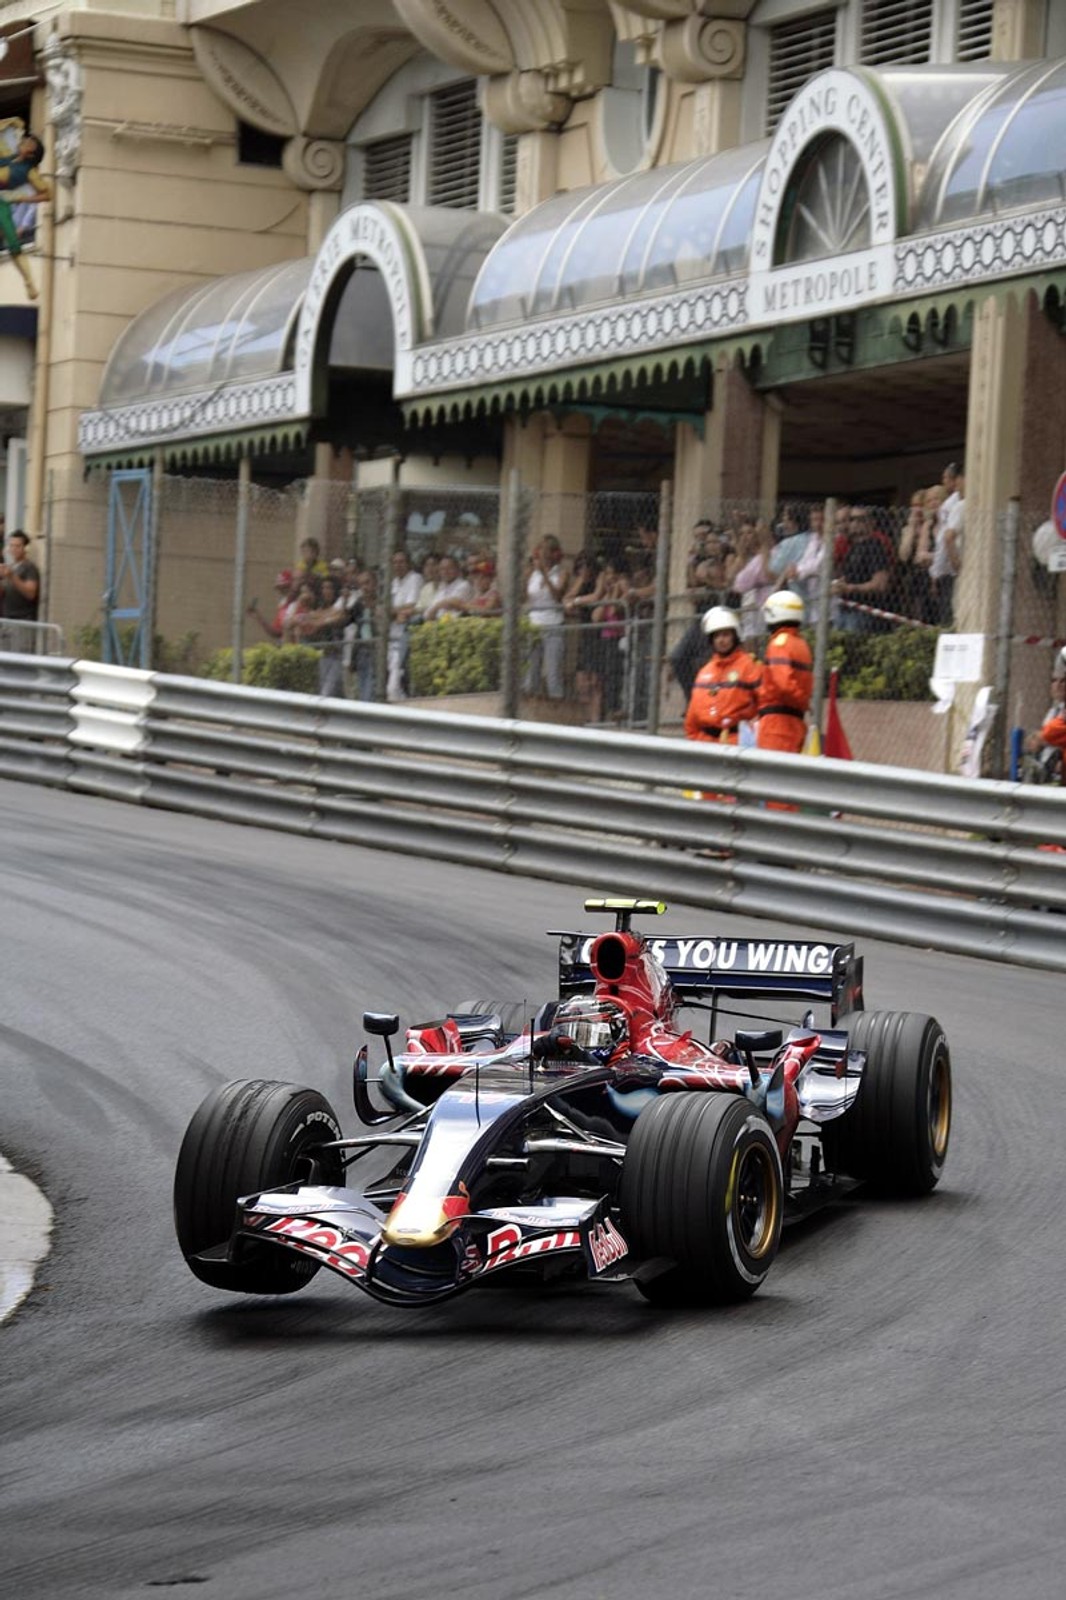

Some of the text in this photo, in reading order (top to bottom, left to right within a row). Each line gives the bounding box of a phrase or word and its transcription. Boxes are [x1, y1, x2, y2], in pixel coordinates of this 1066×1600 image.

[755, 86, 838, 258] SHOPPING
[763, 260, 878, 312] METROPOLE
[677, 939, 738, 969] YOU
[747, 943, 833, 974] WING
